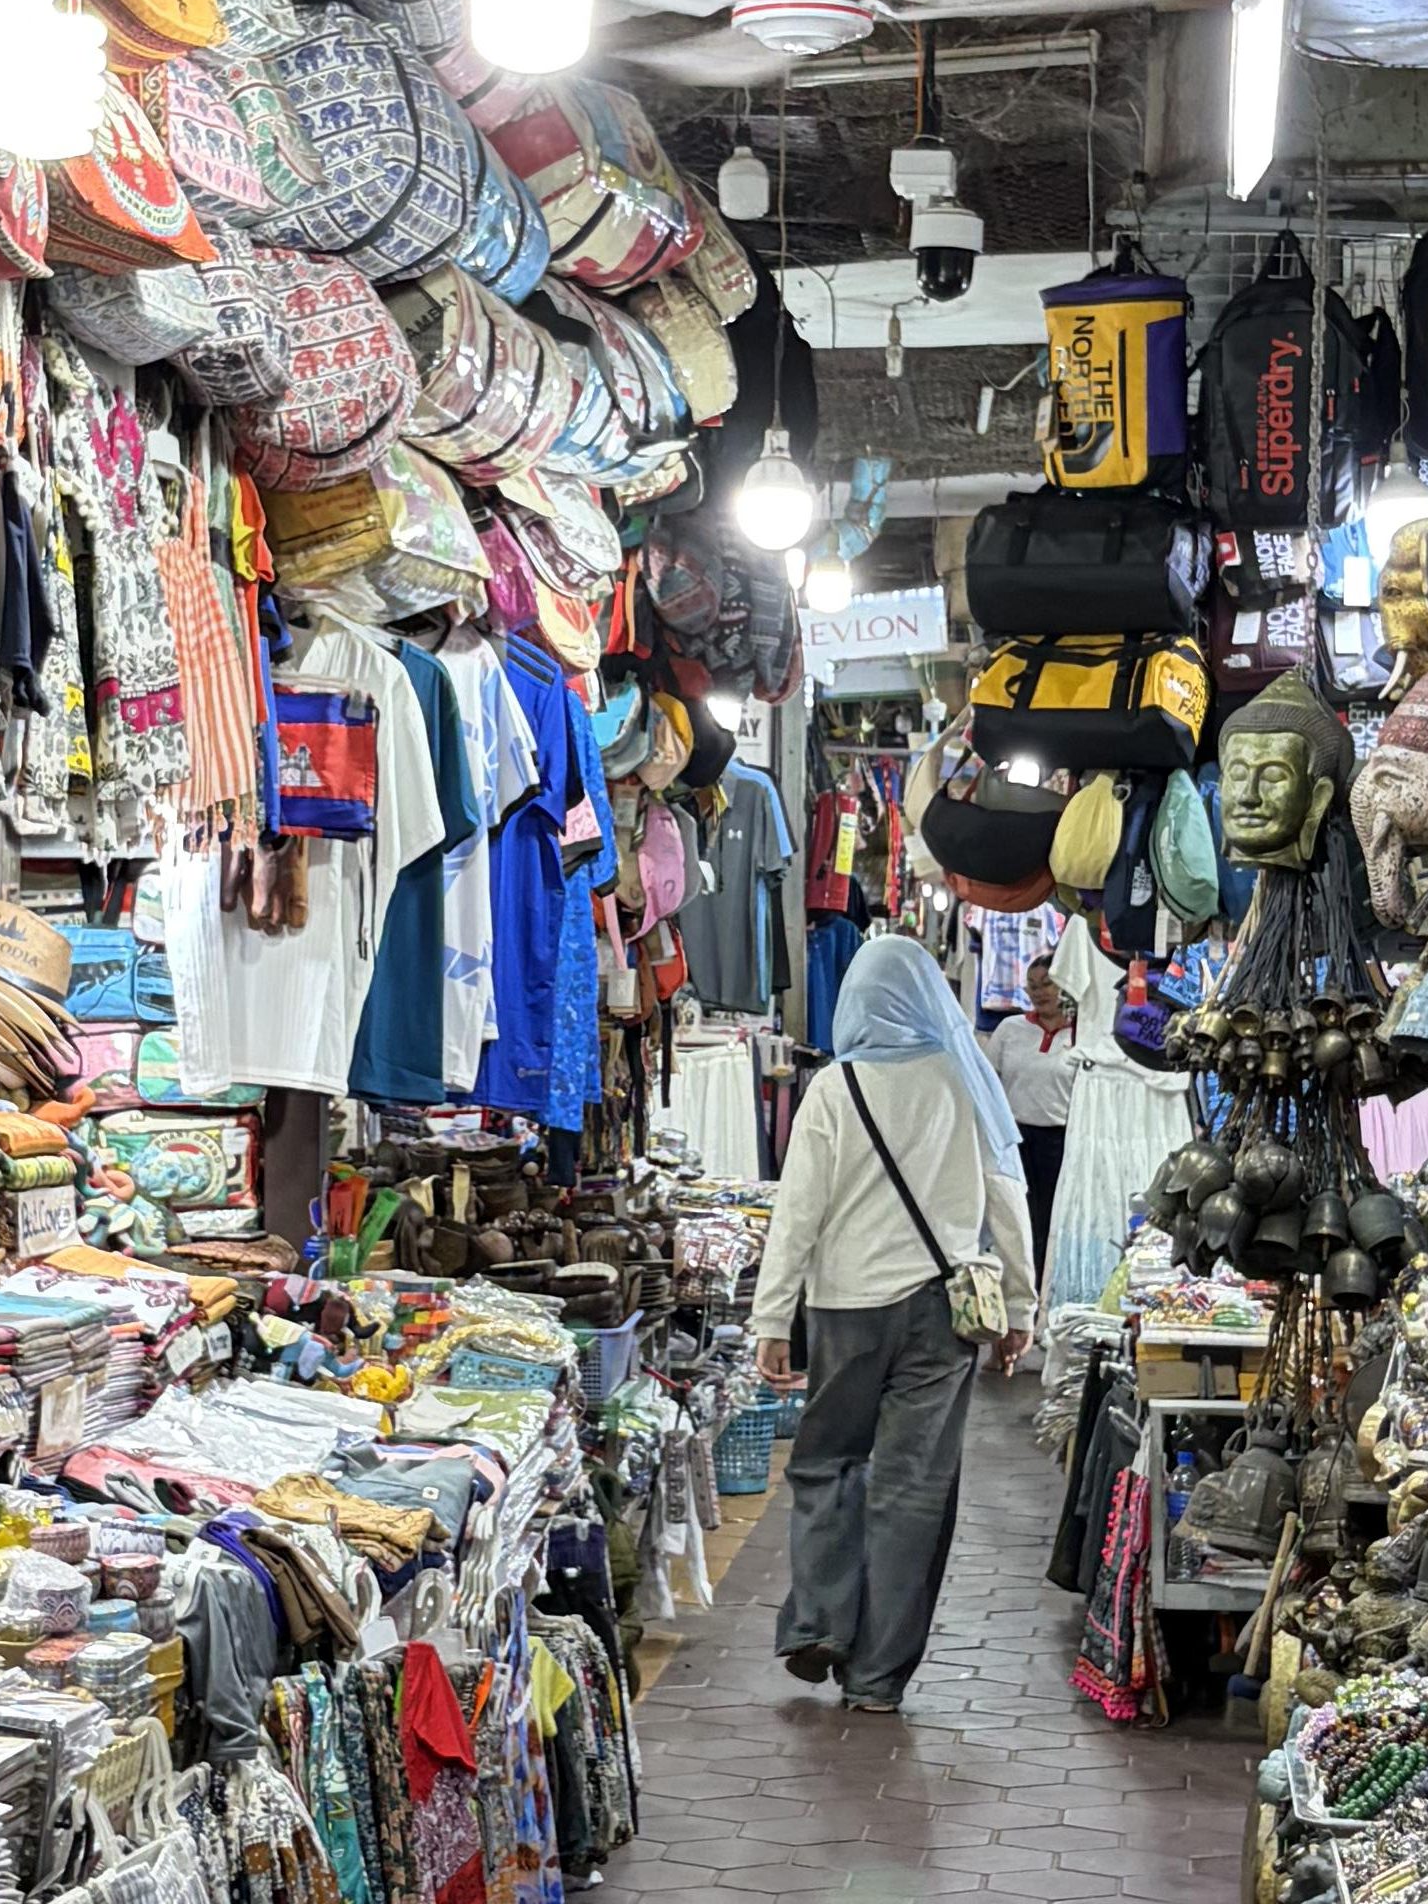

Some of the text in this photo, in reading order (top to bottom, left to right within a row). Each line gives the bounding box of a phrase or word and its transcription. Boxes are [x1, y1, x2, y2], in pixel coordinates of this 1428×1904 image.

[1072, 315, 1096, 419] NORTH
[1093, 359, 1115, 419] THE
[1272, 533, 1296, 578] FACE
[803, 614, 919, 647] EVLON
[193, 1134, 222, 1164] BRAND
